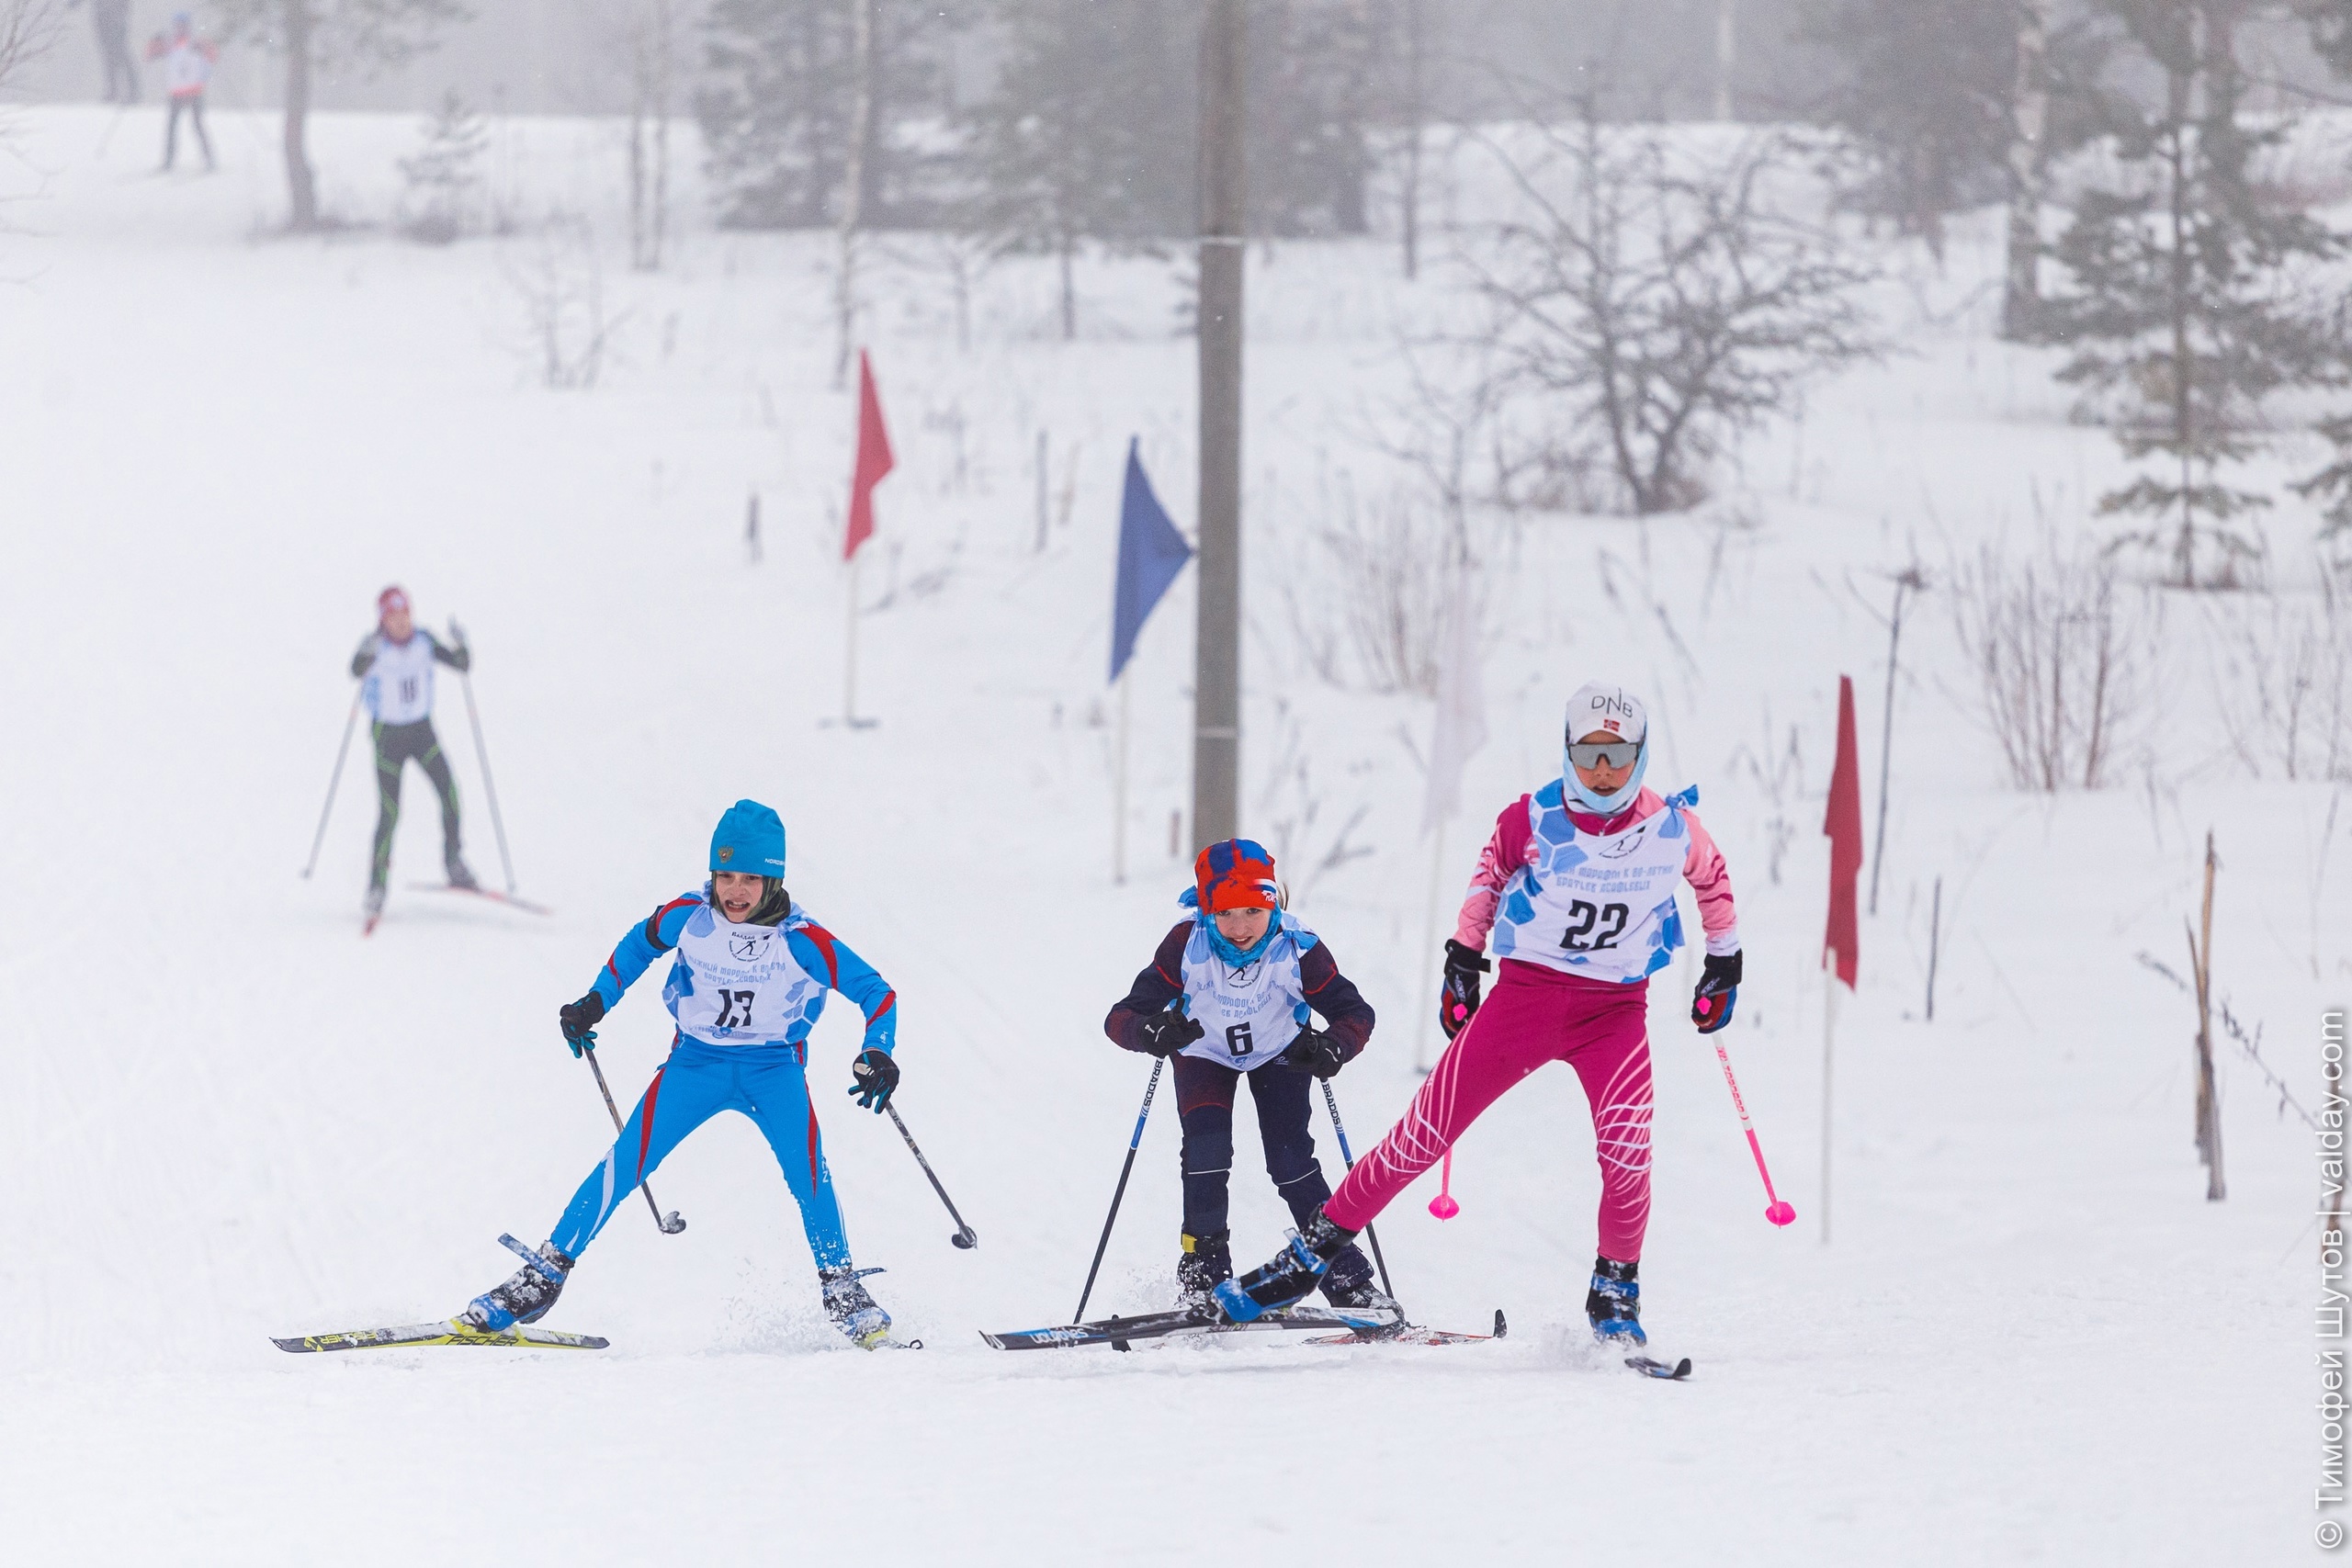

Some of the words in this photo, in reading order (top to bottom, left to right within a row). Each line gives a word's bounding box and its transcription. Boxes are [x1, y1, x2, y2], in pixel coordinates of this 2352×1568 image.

[1591, 687, 1633, 718] DNB
[1559, 899, 1629, 951] 22
[714, 989, 755, 1028] 13
[1226, 1021, 1254, 1056] 6
[1143, 1058, 1164, 1108] BRADDS
[1321, 1083, 1341, 1126] BRADDS
[446, 1334, 519, 1347] FISCHER
